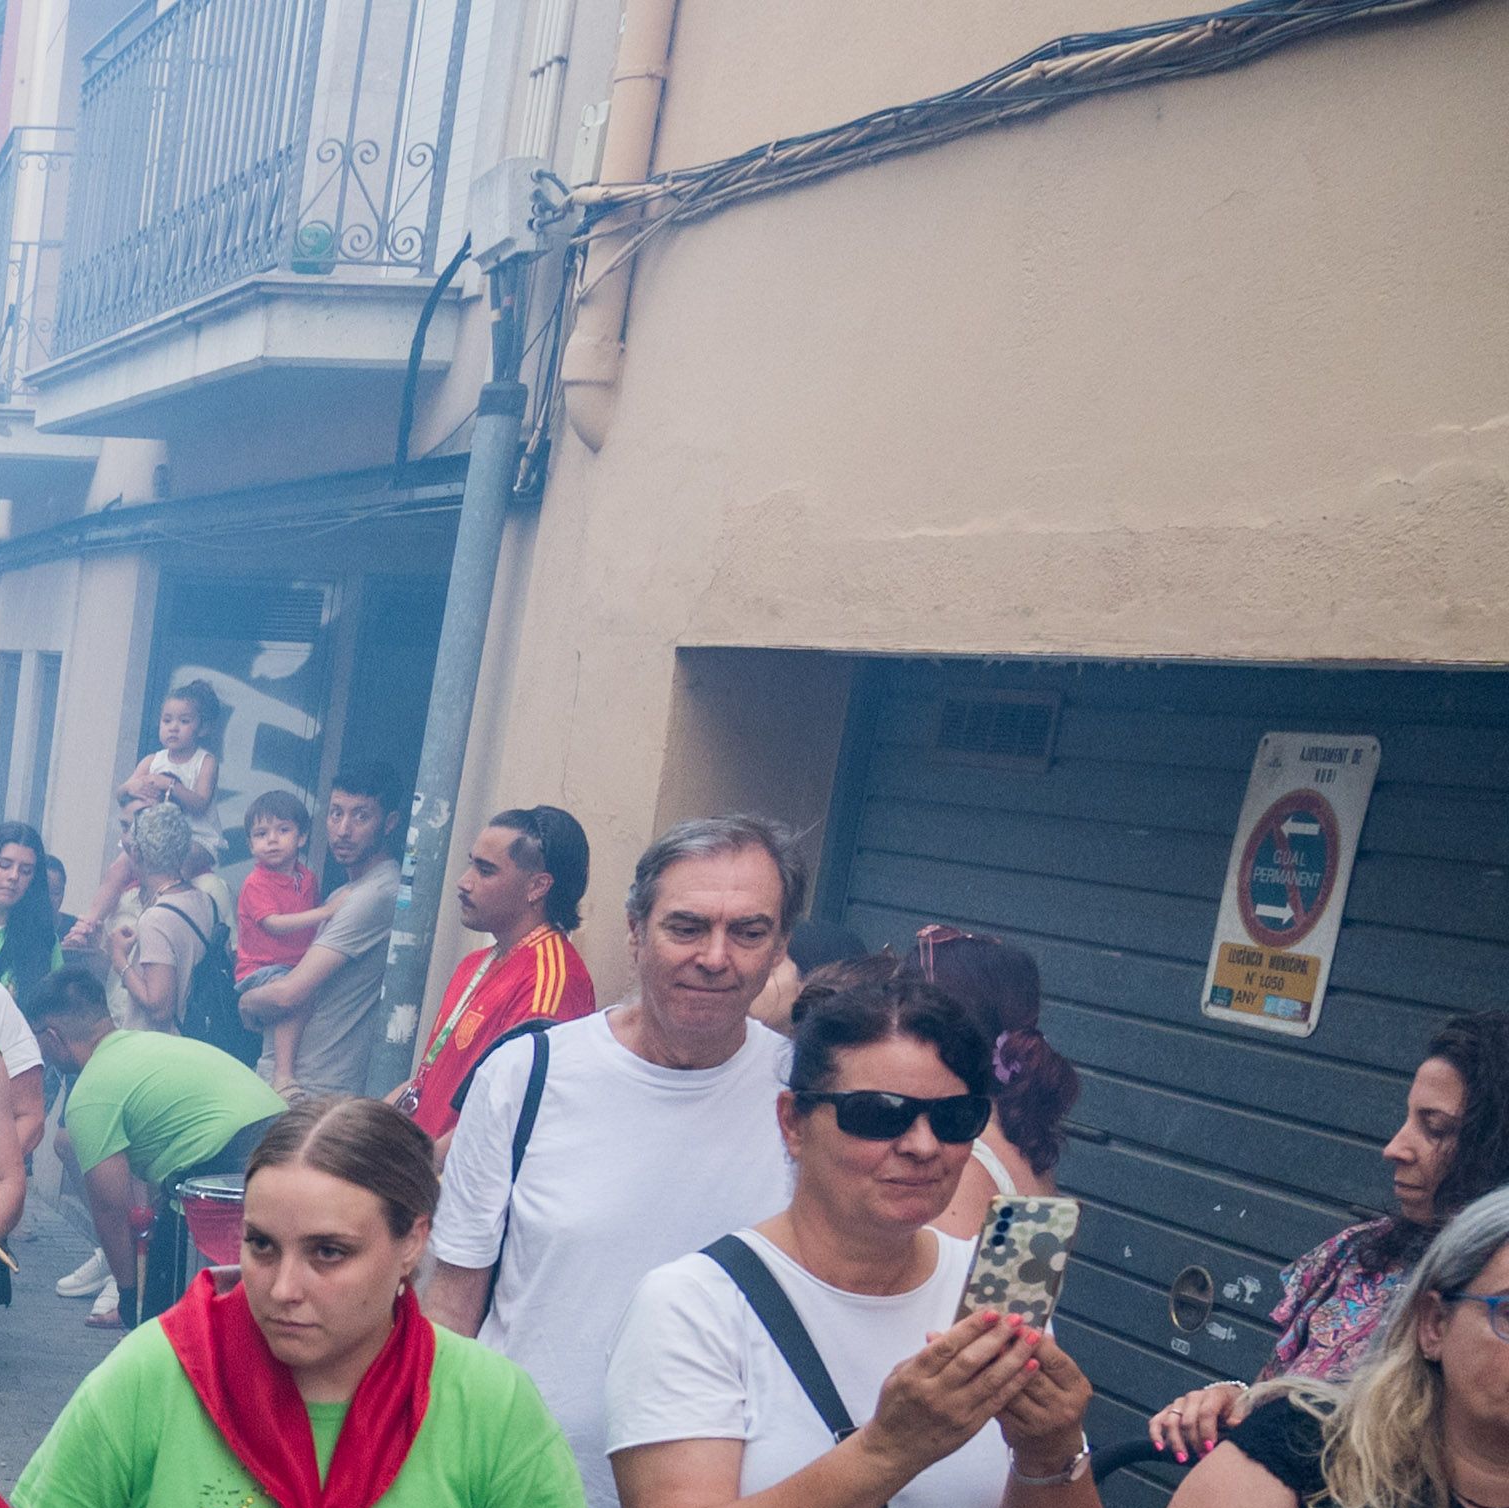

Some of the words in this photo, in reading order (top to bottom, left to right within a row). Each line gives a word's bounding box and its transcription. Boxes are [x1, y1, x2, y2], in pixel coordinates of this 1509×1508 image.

[1272, 849, 1307, 867] GUAL
[1252, 866, 1322, 888] PERMANENT
[1235, 988, 1259, 1006] ANY
